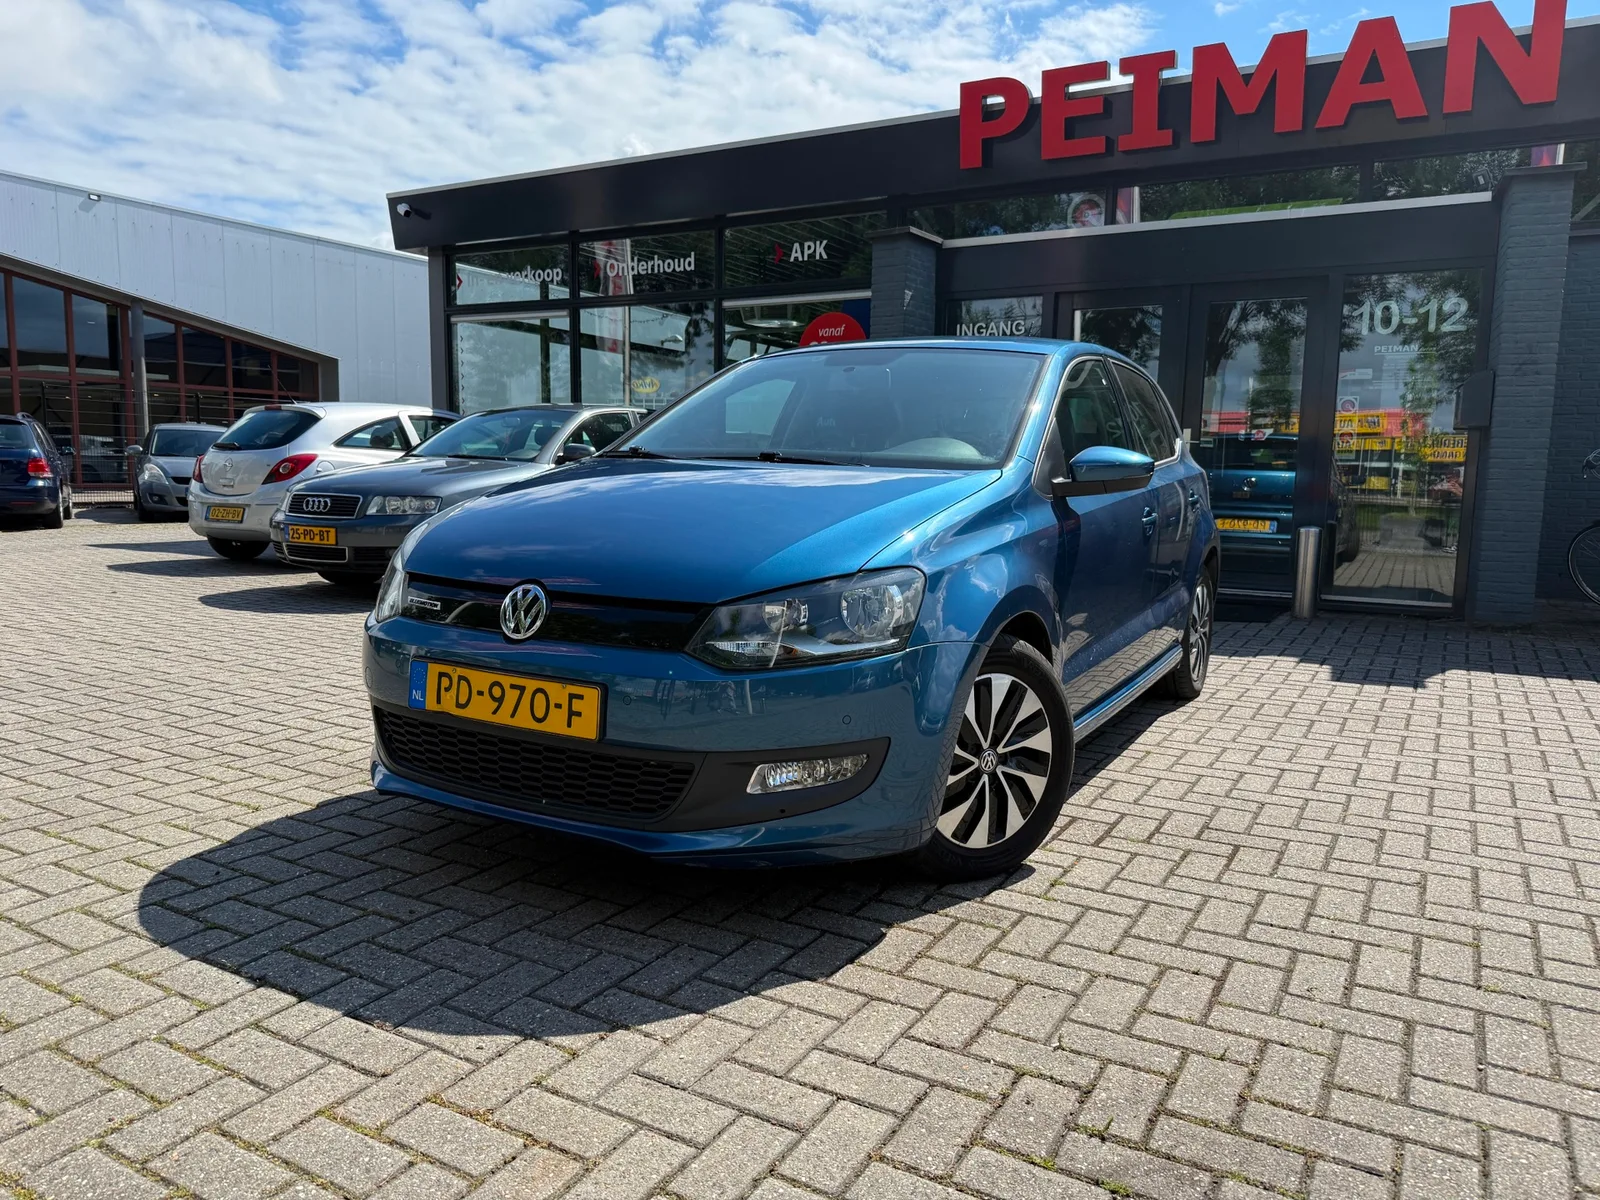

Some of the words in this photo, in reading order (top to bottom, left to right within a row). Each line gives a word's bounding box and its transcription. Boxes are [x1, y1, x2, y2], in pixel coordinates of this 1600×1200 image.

[959, 0, 1567, 170] PEIMAN
[789, 240, 828, 263] APK
[606, 251, 695, 278] Onderhoud
[1354, 297, 1470, 337] 10-12
[818, 324, 846, 337] vanaf
[956, 319, 1026, 337] INGANG
[1374, 344, 1418, 354] PEIMAN
[211, 508, 242, 519] 02-ZH-BV
[290, 528, 331, 542] 25-PD-BT
[412, 689, 424, 702] NL
[435, 671, 585, 729] PD-970-F
